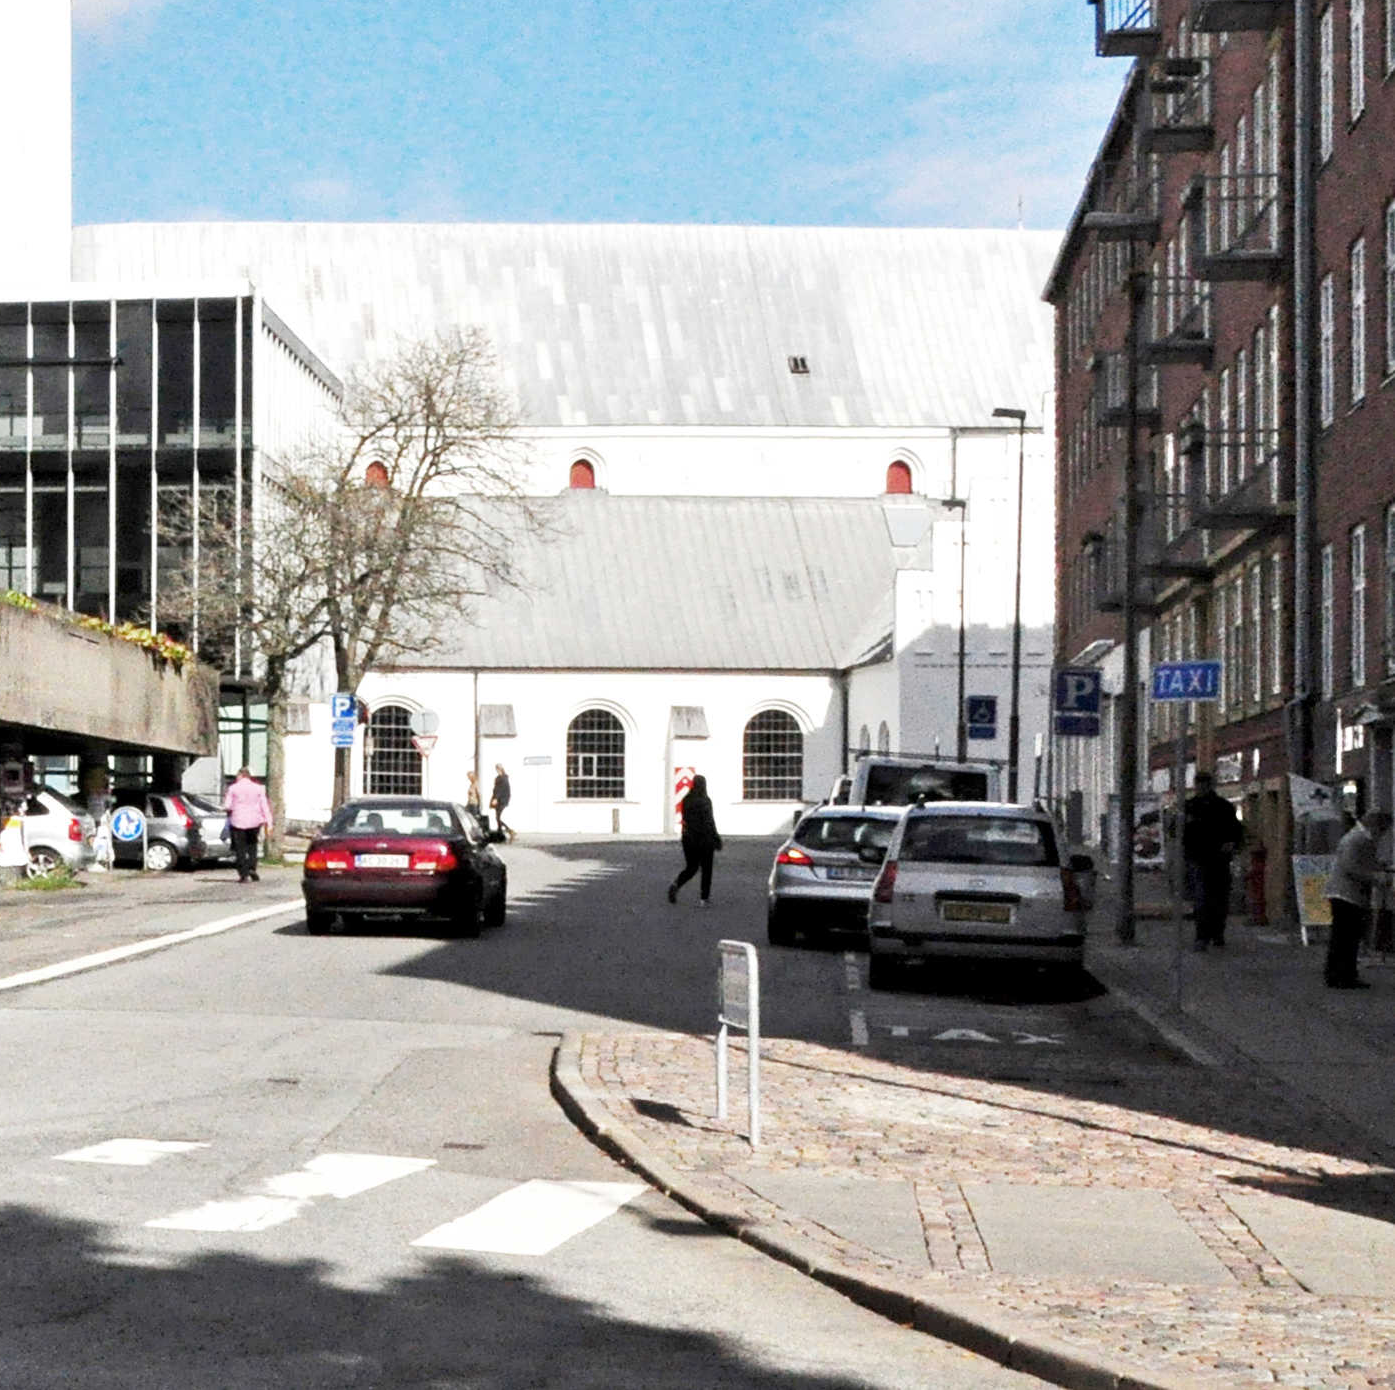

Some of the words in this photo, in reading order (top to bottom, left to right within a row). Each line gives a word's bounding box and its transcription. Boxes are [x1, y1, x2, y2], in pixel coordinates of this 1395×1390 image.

[1065, 675, 1095, 708] P
[1158, 669, 1212, 692] TAXI
[335, 697, 351, 718] P
